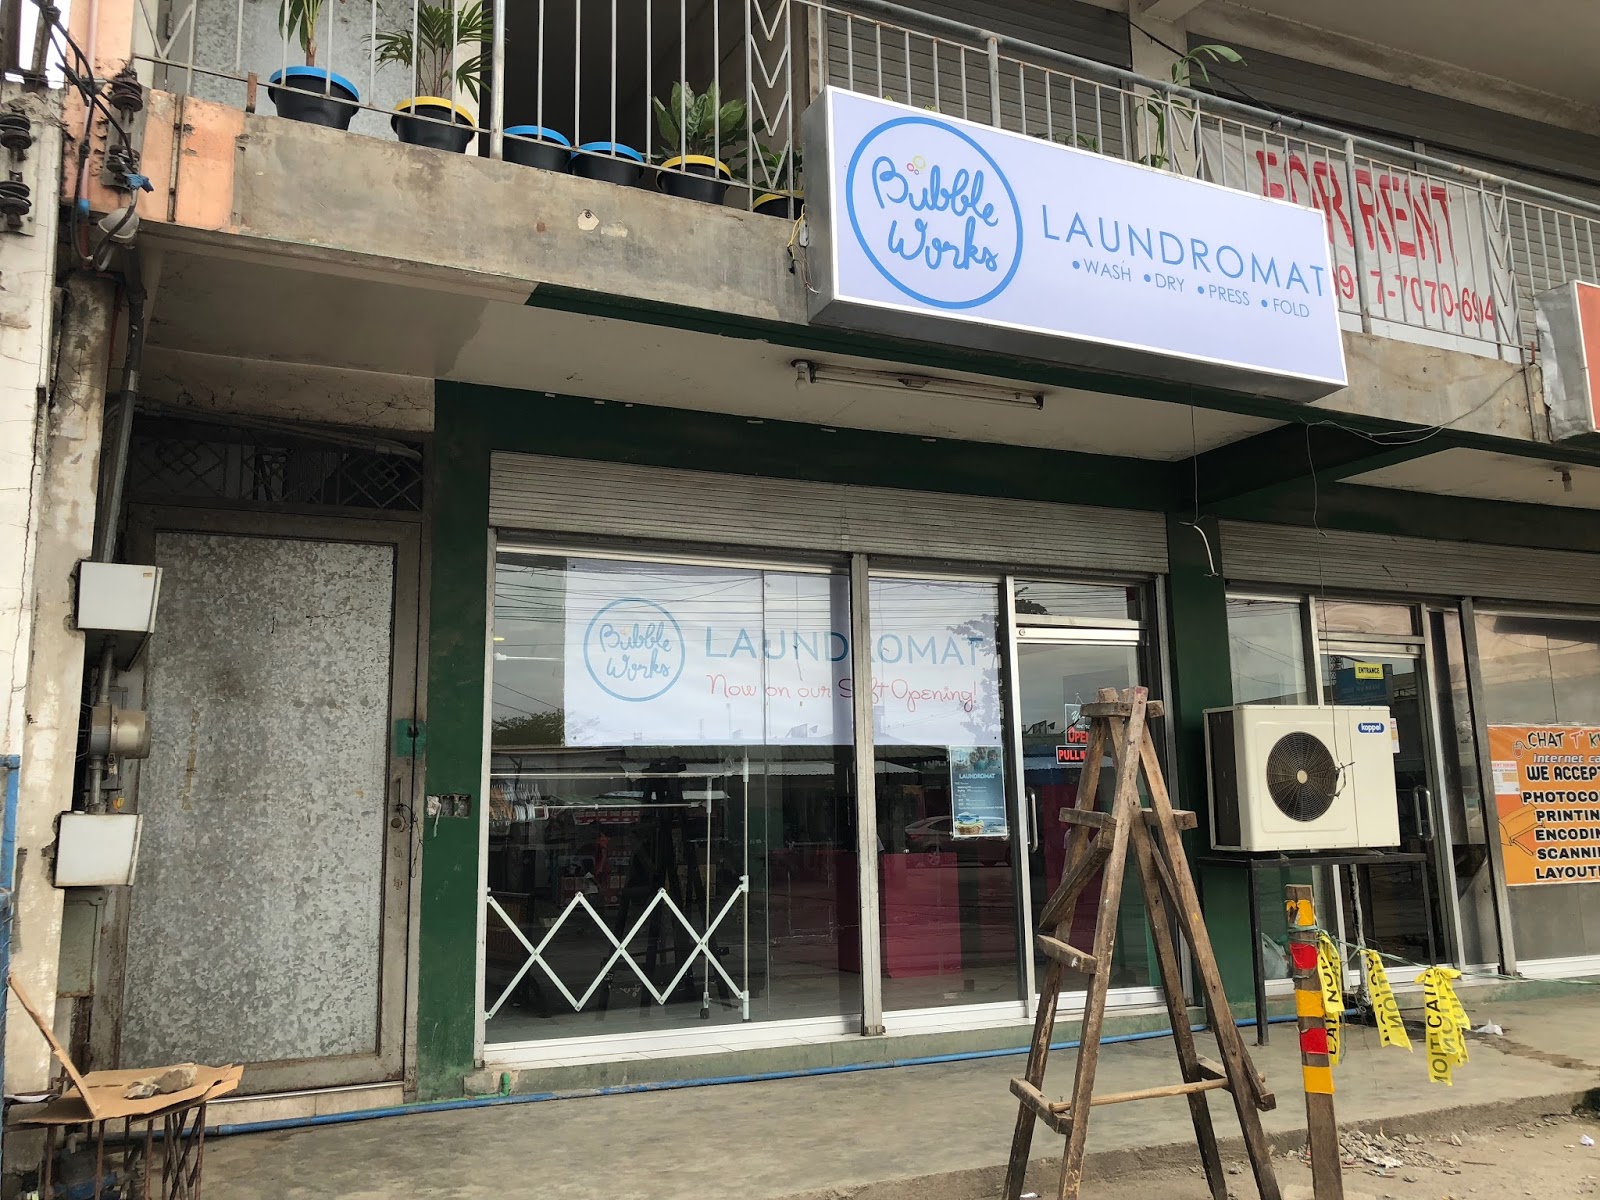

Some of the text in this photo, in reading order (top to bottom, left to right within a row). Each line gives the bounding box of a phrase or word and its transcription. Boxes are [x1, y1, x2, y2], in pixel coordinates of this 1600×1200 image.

[872, 156, 998, 227] Bubble
[1355, 169, 1458, 266] RENT
[888, 216, 998, 271] Works
[1042, 204, 1324, 296] LAUNDROMAT
[1083, 258, 1310, 318] WASH DRY PRESS FOLD
[600, 622, 672, 652] Bubble
[705, 626, 983, 666] LAUNDOMAT
[606, 648, 671, 681] Works
[706, 674, 978, 712] Now on our Sft Opening!
[1058, 749, 1080, 761] PULL
[1527, 732, 1565, 748] CHAT
[1526, 766, 1550, 781] WE
[1533, 753, 1584, 764] internet
[1537, 846, 1600, 860] SCANNI
